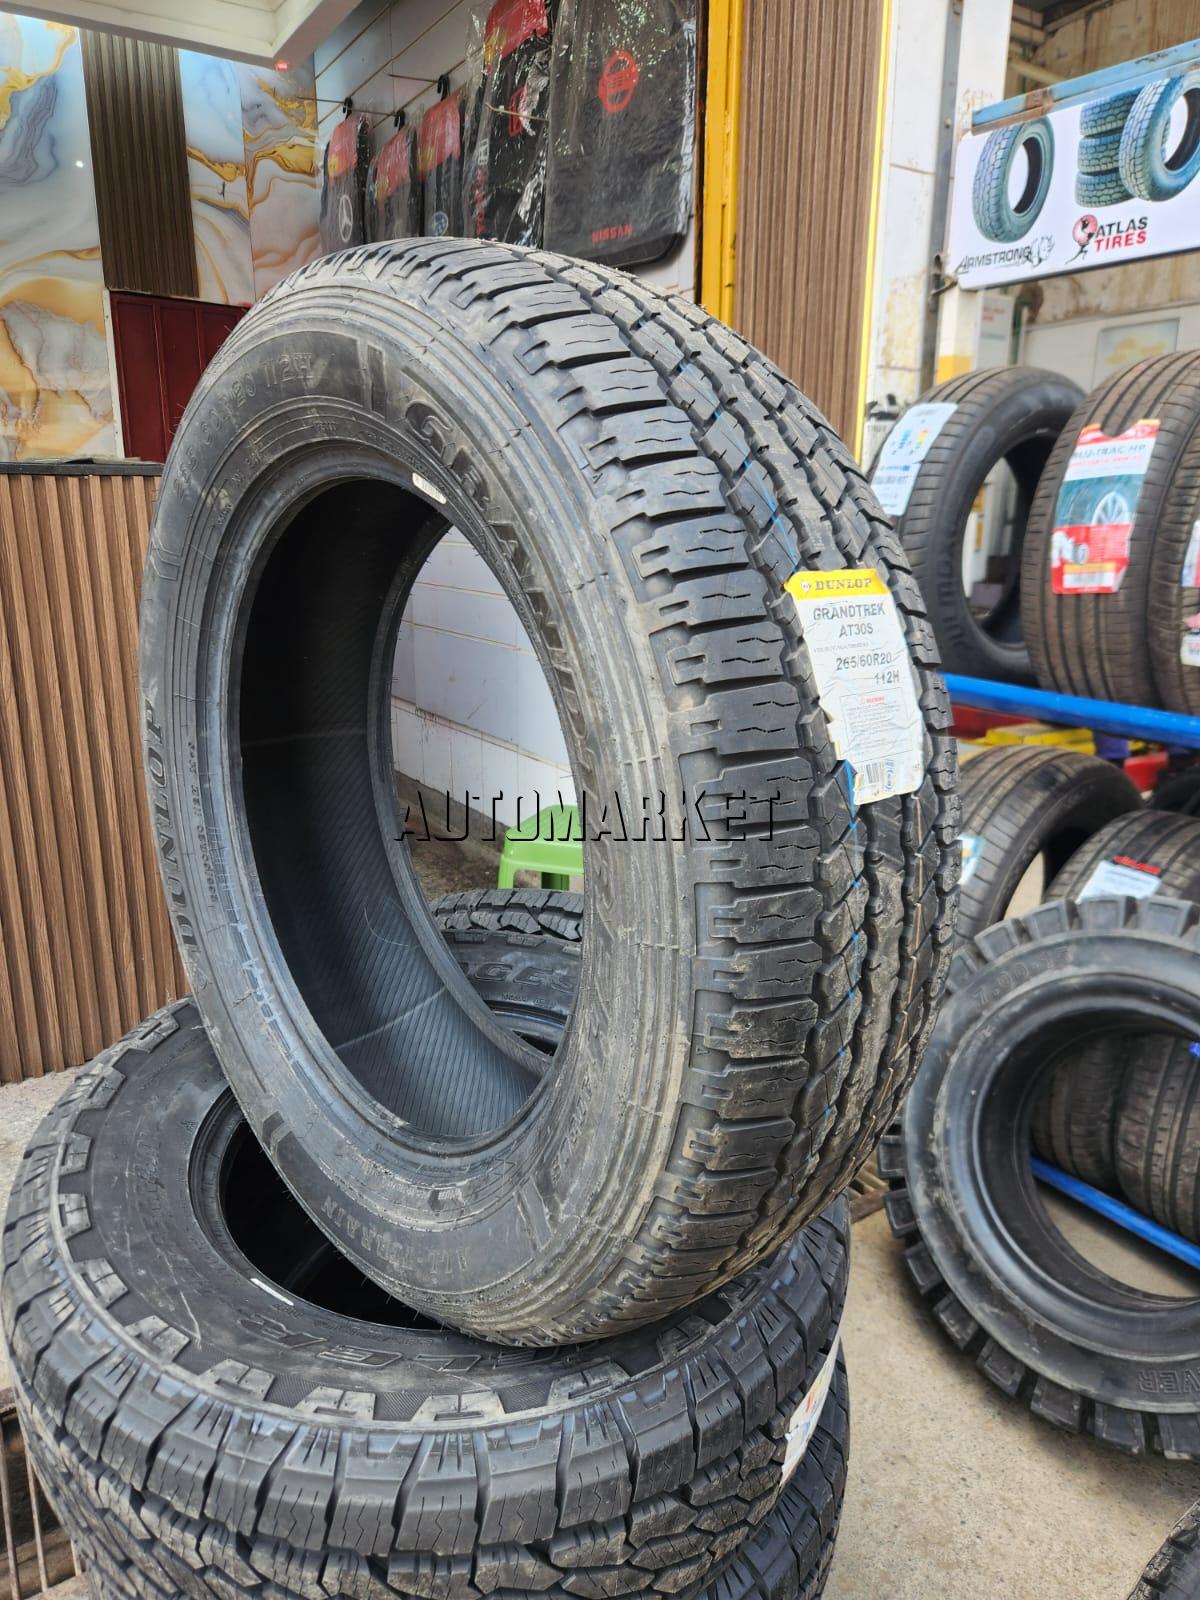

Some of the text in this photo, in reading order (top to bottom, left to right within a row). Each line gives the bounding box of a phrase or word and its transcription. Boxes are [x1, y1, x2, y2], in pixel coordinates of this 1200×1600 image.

[591, 224, 634, 244] NISSAN
[1095, 217, 1148, 237] ATLAS
[1094, 230, 1147, 252] TIRES
[955, 245, 1031, 274] ARMSTRONG
[814, 577, 873, 591] DUNLOP
[812, 603, 886, 621] GRANDTREK
[838, 622, 874, 638] AT30S
[835, 651, 893, 671] 265/60R20
